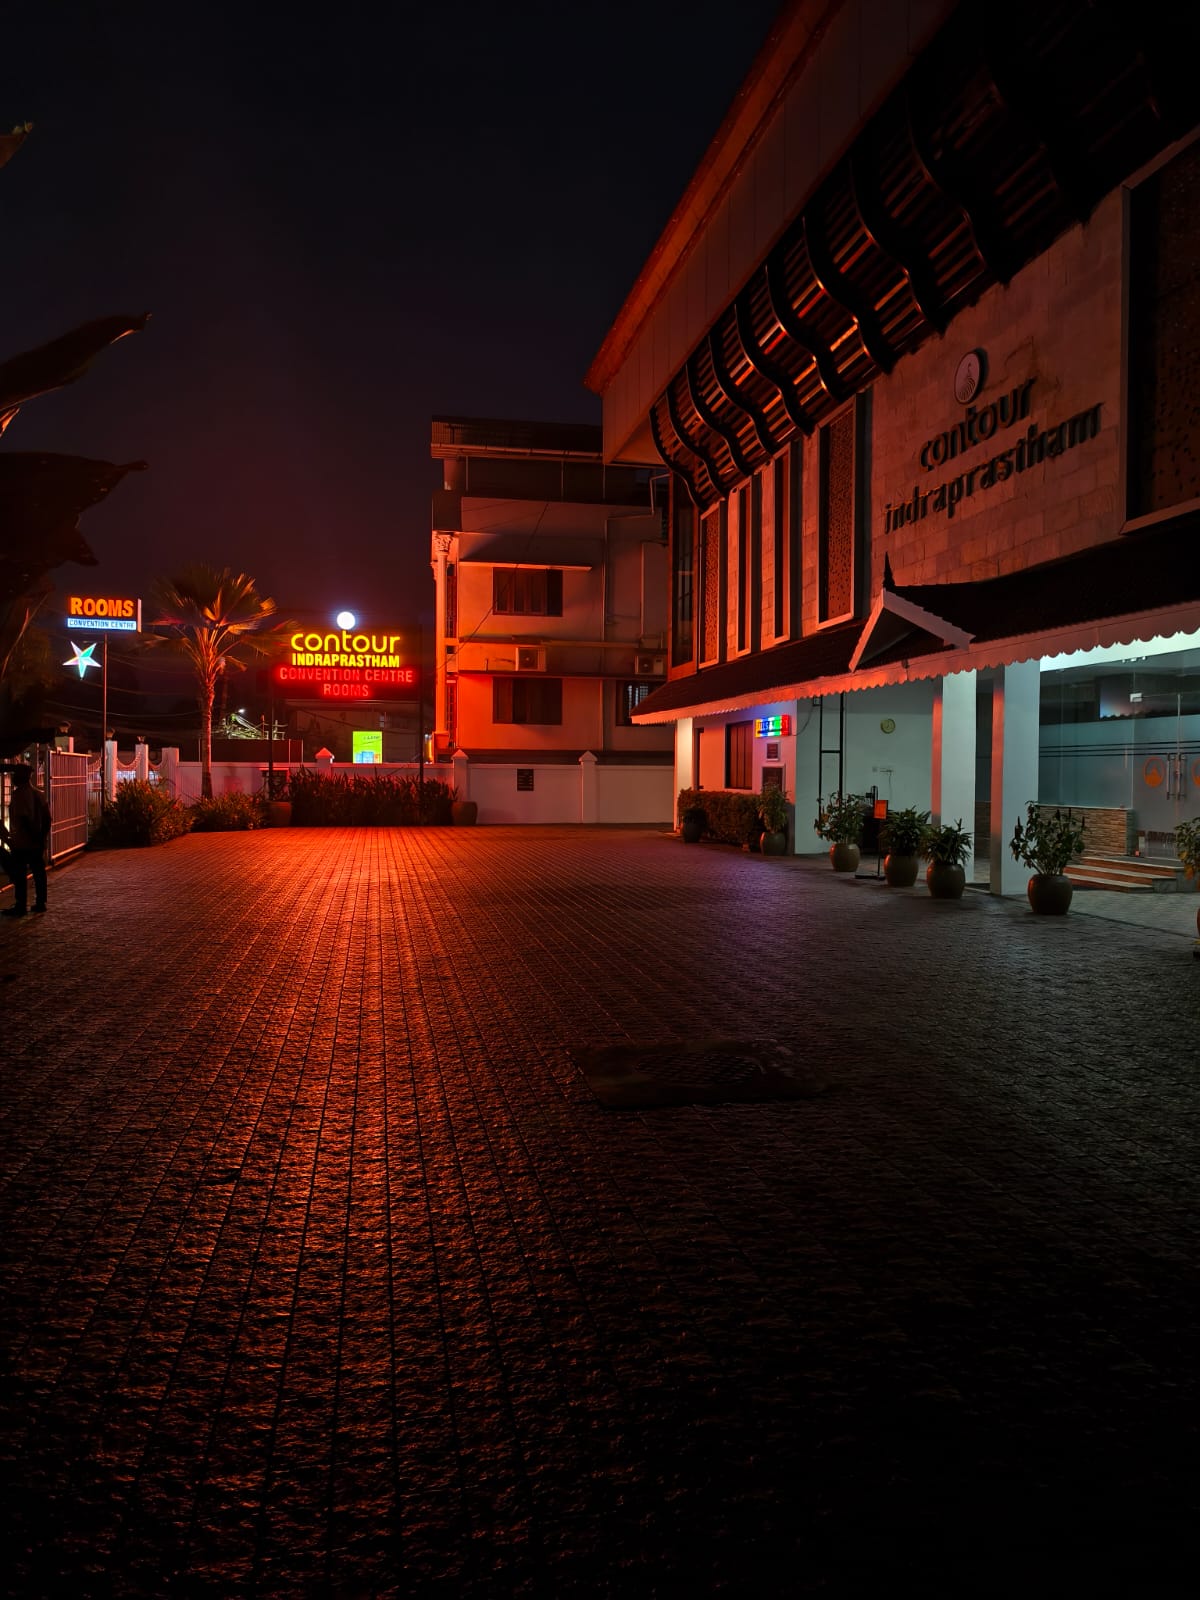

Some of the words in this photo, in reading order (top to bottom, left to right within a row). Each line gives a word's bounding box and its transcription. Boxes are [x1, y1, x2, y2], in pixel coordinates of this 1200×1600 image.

[920, 376, 1037, 472] contour
[885, 402, 1104, 534] indraprastham
[70, 597, 134, 617] ROOMS
[69, 619, 109, 629] CONVENTION
[111, 621, 135, 629] CENTRE
[291, 630, 401, 653] contour
[292, 653, 400, 668] INDRAPRASTHAM
[280, 667, 360, 681] CONVENTION
[365, 669, 413, 683] CENTRE
[323, 683, 369, 697] ROOMS
